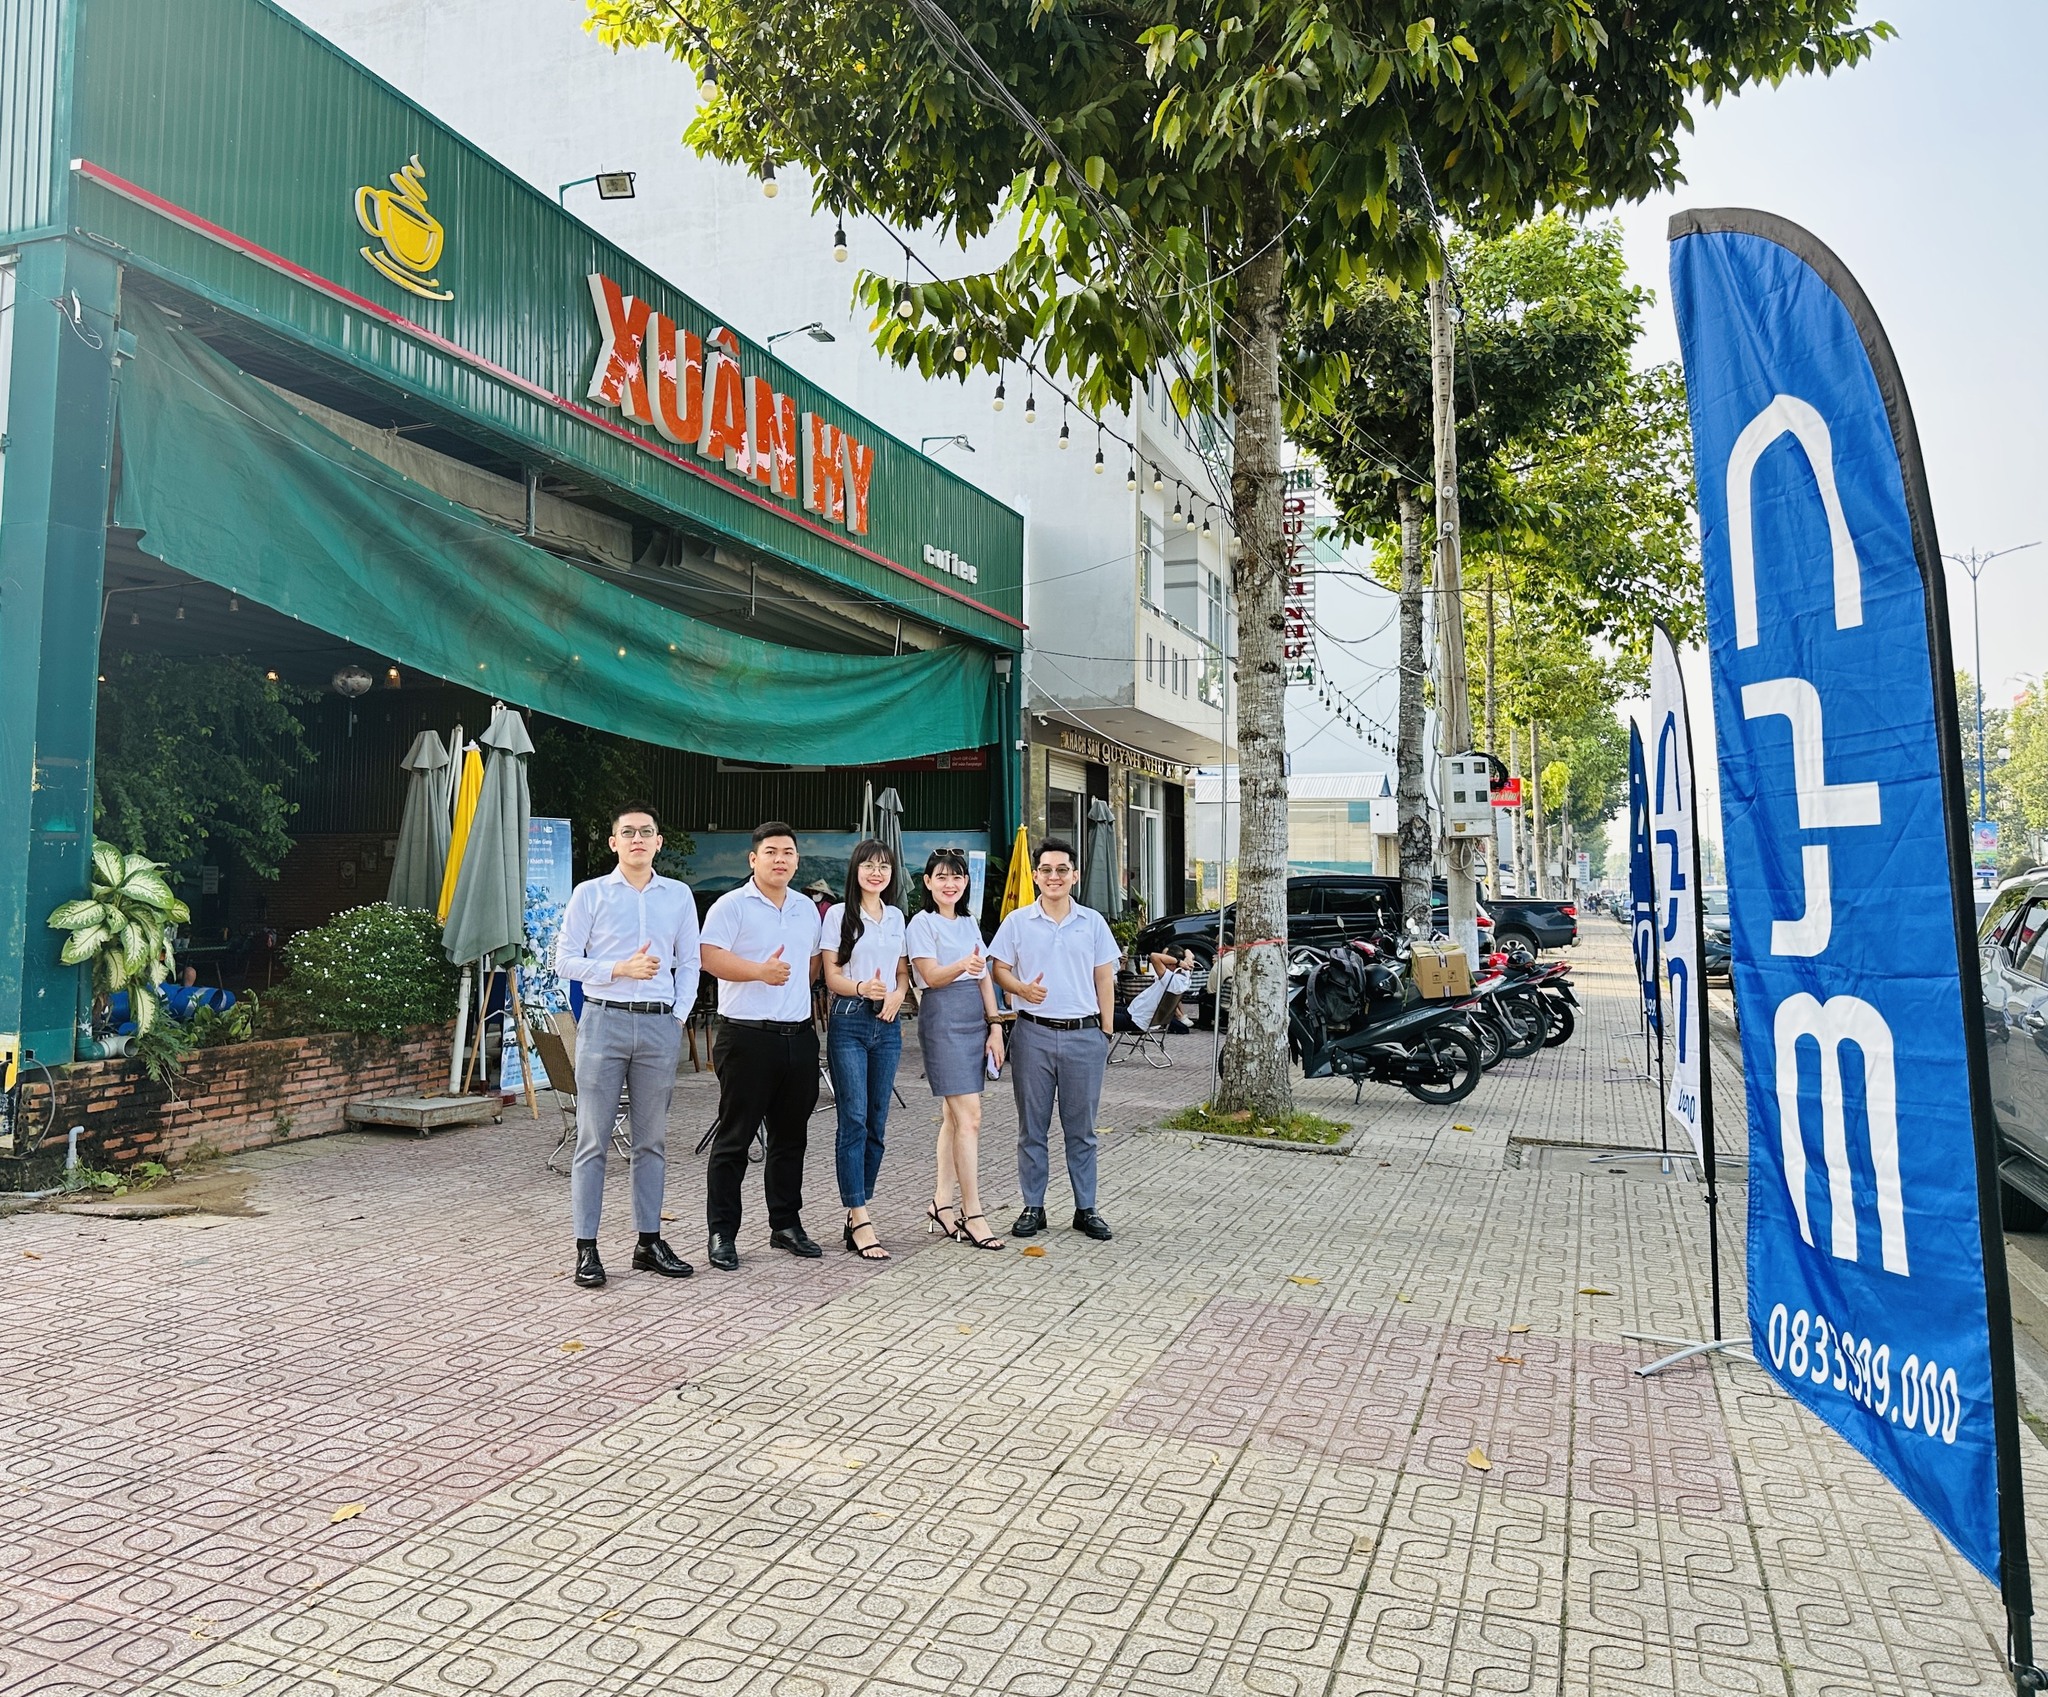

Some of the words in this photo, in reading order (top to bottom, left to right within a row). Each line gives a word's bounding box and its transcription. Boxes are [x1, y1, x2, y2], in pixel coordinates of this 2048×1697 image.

[587, 273, 797, 500] XUÂN
[801, 412, 874, 535] HY
[923, 544, 977, 584] coffee
